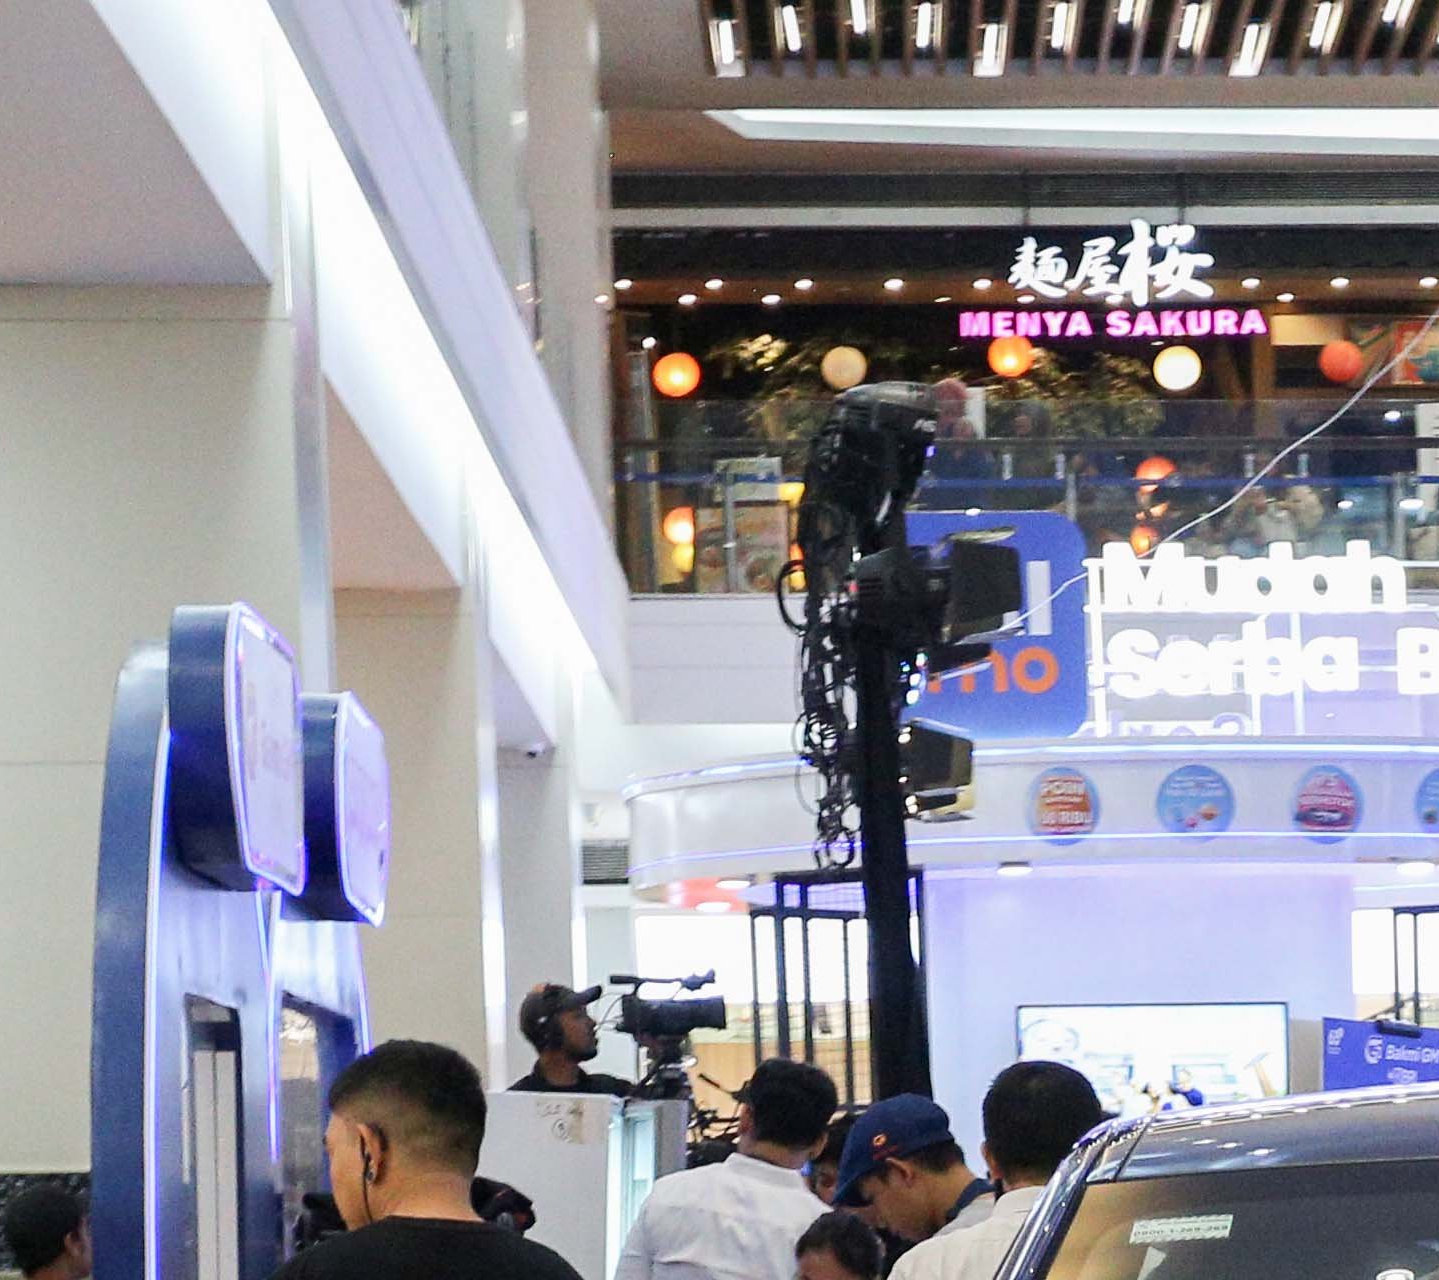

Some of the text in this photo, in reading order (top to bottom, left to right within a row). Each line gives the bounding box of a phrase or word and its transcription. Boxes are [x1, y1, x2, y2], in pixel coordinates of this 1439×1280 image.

[959, 309, 1268, 338] MENYA SAKURA
[1101, 540, 1408, 612] Mudah
[1106, 620, 1360, 698] Serba
